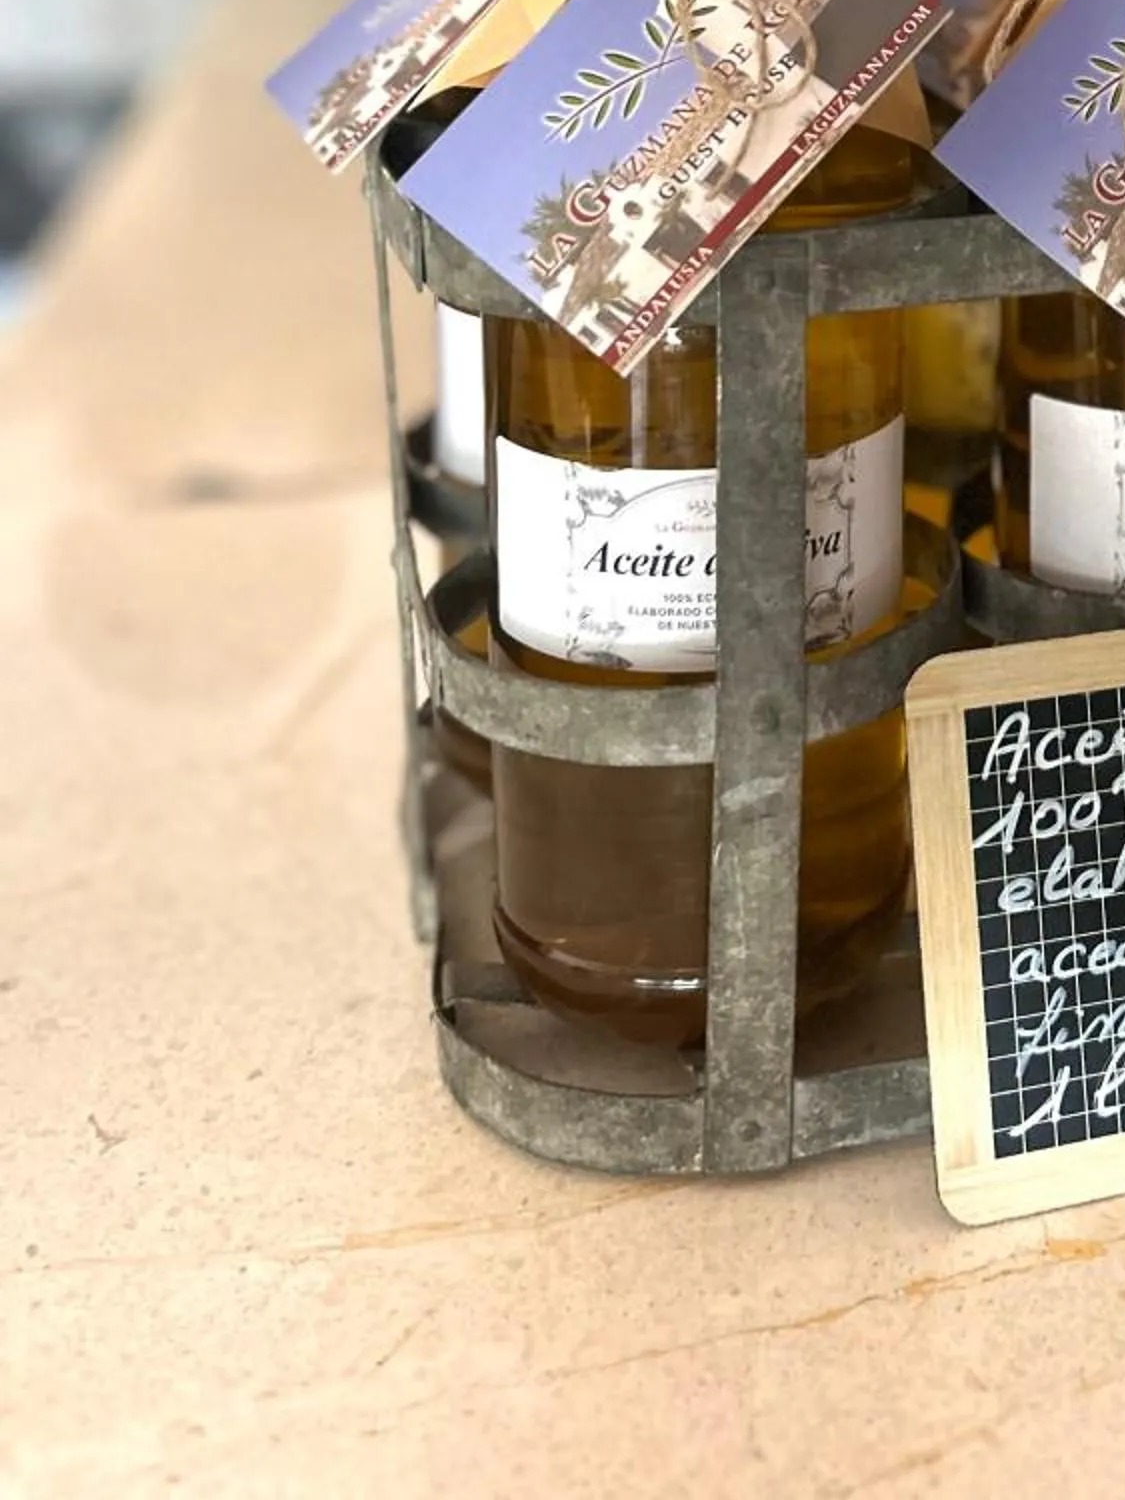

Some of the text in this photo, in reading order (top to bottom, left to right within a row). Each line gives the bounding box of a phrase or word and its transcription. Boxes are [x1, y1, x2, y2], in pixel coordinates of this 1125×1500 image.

[790, 1, 934, 158] LAGUZMANA.COM
[528, 231, 578, 278] LA
[712, 41, 753, 81] DE
[657, 133, 727, 203] GUEST
[1062, 209, 1107, 251] LA
[613, 245, 715, 356] ANDALUSIA
[583, 540, 695, 578] Aceite
